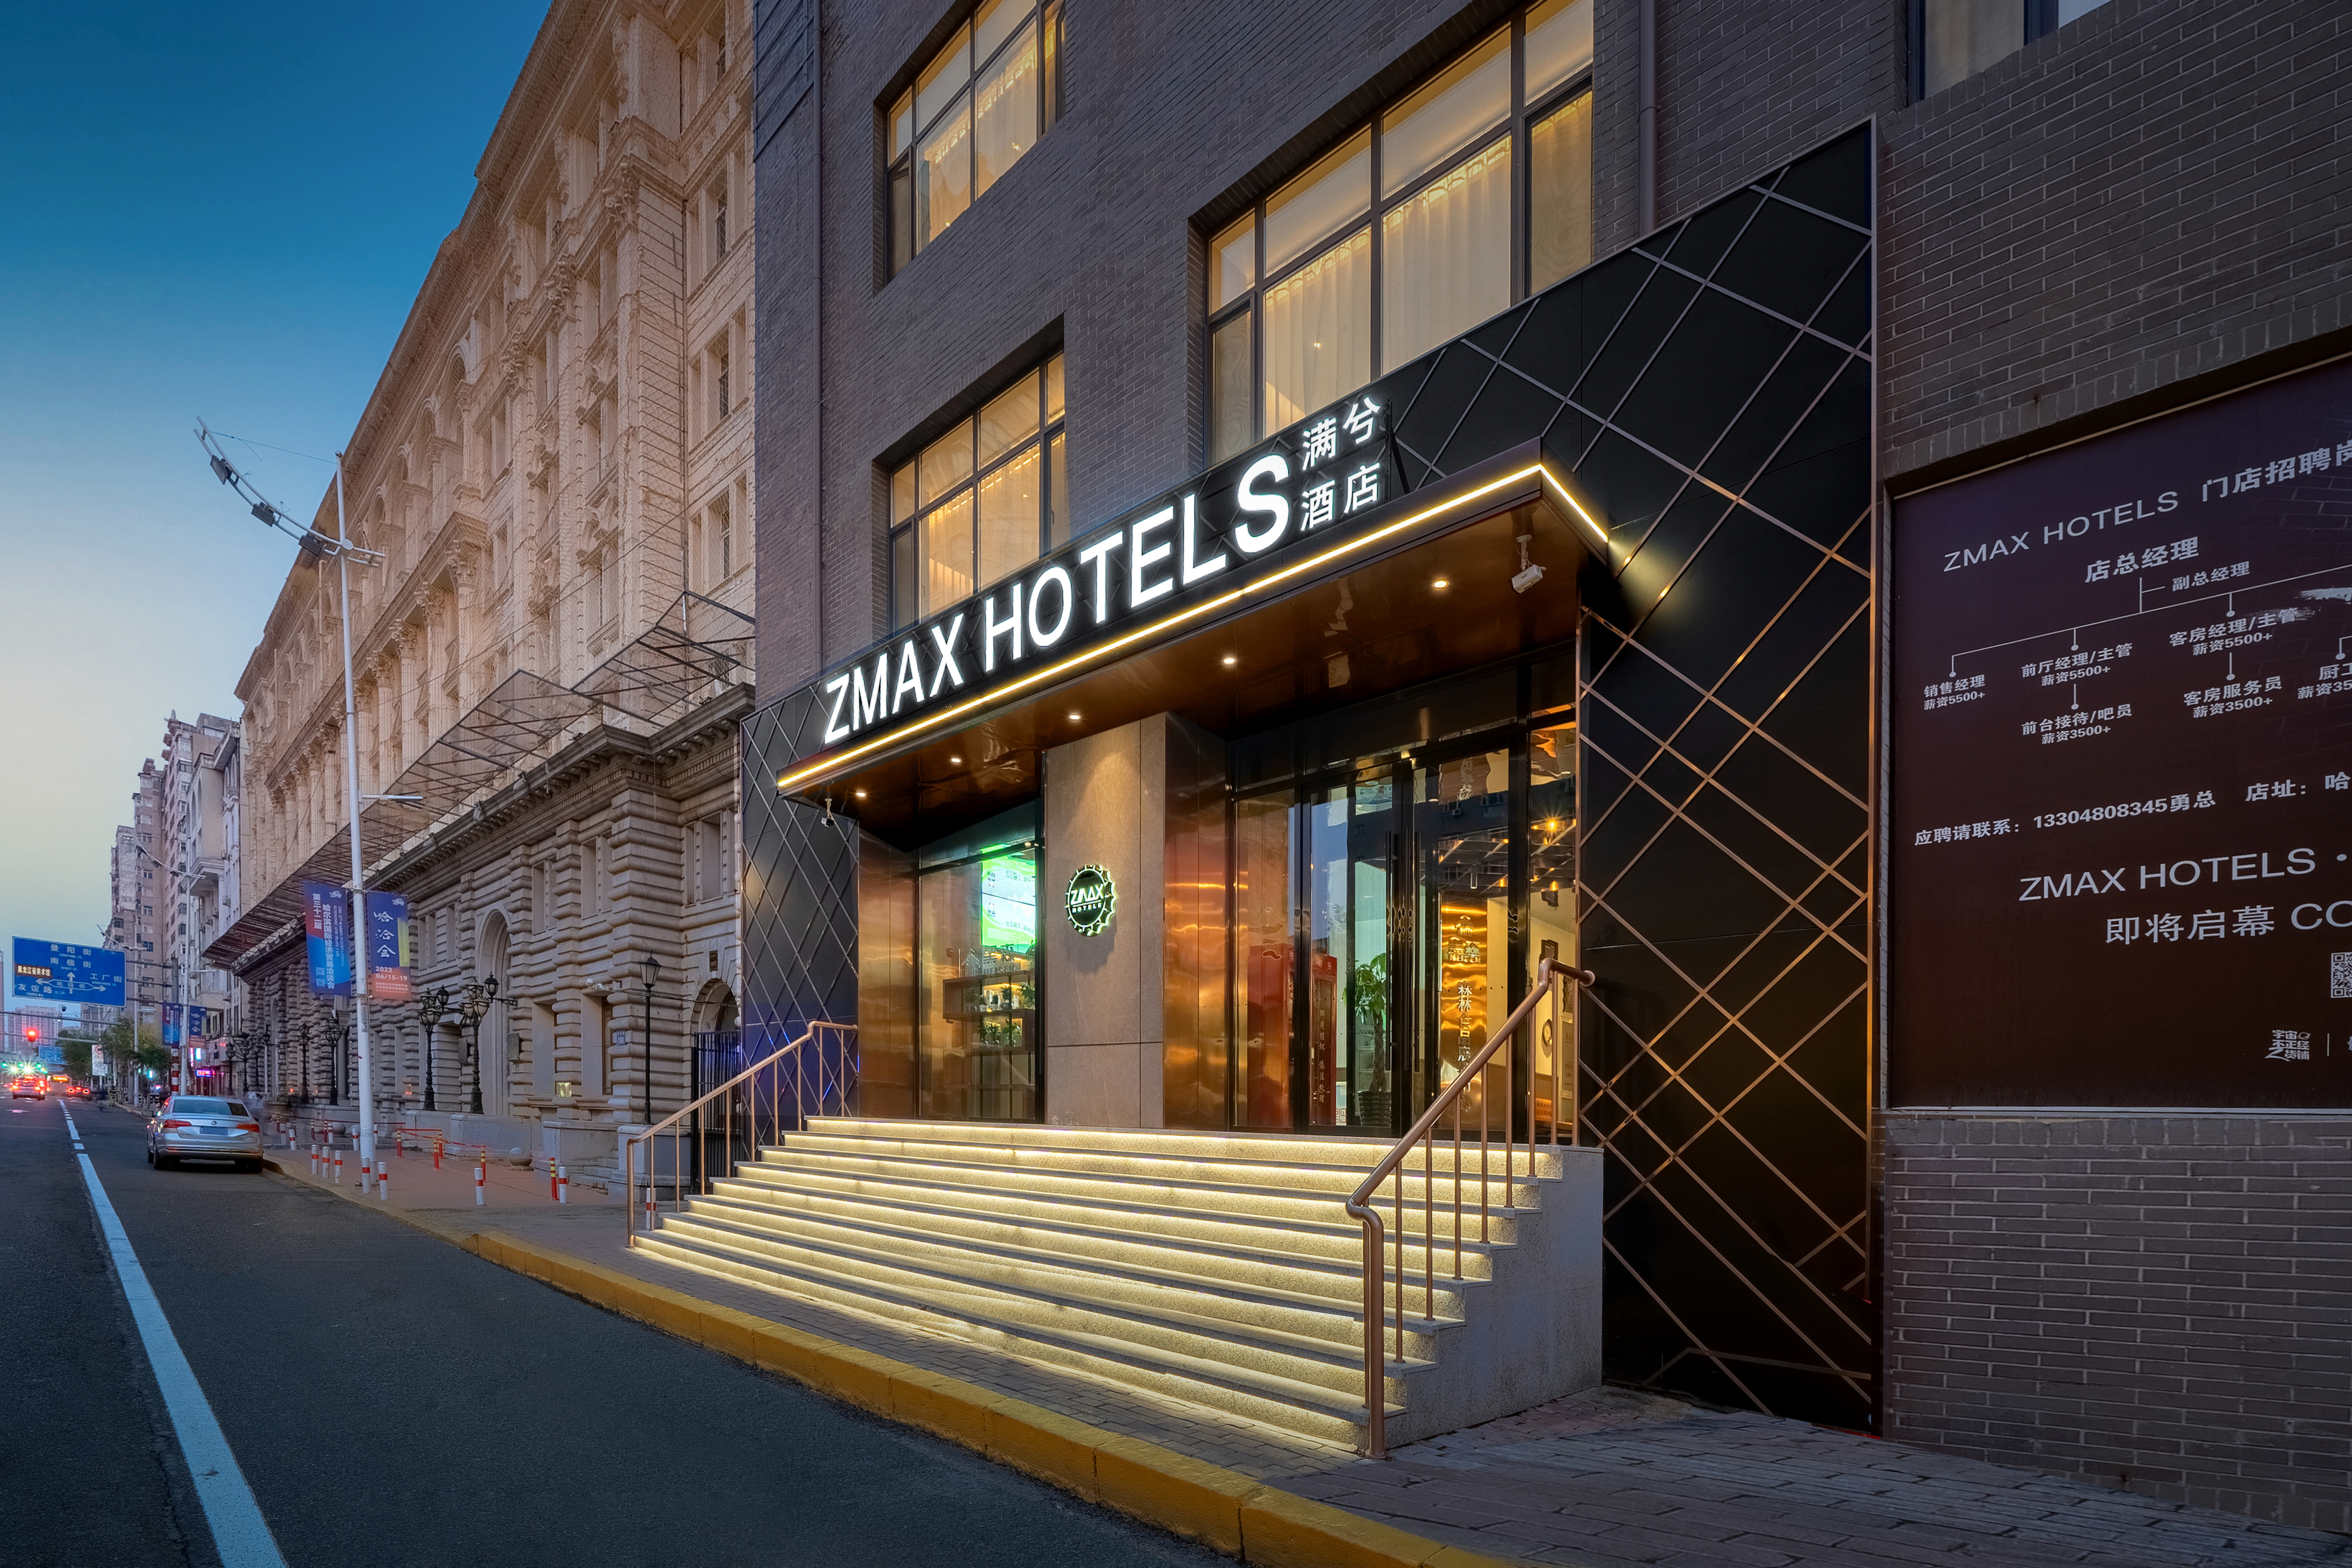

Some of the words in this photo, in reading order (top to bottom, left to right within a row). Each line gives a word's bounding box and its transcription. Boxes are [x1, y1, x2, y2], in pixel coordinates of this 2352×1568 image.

[1302, 397, 1380, 470] 满兮
[1301, 462, 1380, 531] 酒店
[1944, 531, 2029, 572] ZMAX
[2044, 491, 2179, 544] HOTELS
[2085, 536, 2199, 583] 店总经理
[2172, 561, 2250, 592] 副总经理
[824, 612, 965, 744] ZMAX
[984, 453, 1290, 673] HOTELS
[2169, 607, 2297, 647] 客房经理/主管
[2192, 632, 2273, 656] 薪资5500+
[2020, 642, 2132, 678] 前厅经理/主管
[2041, 665, 2111, 686] 薪资5500+
[1923, 674, 1985, 698] 销售经理
[1923, 691, 1985, 710] 薪资5500+
[2183, 675, 2283, 706] 客房服务员
[2022, 703, 2132, 735] 前台接待/吧员
[2193, 696, 2273, 718] 薪资3500+
[2041, 725, 2111, 745] 薪资3500+
[2019, 867, 2126, 901] ZMAX
[2140, 848, 2315, 889] HOTELS
[1070, 884, 1104, 905] ZMAX
[1072, 902, 1102, 913] HOTELS
[312, 893, 322, 930] 第三十二届
[2106, 905, 2275, 945] 即将启幕
[50, 944, 91, 956] 景阳街
[373, 911, 396, 958] 哈洽会
[50, 957, 91, 968] 南极街
[1449, 954, 1481, 963] HEISEN
[18, 983, 52, 994] 友谊路
[90, 972, 122, 983] 工厂街
[1456, 978, 1472, 1112] 森林食品展心
[2272, 1029, 2297, 1040] 宇宙
